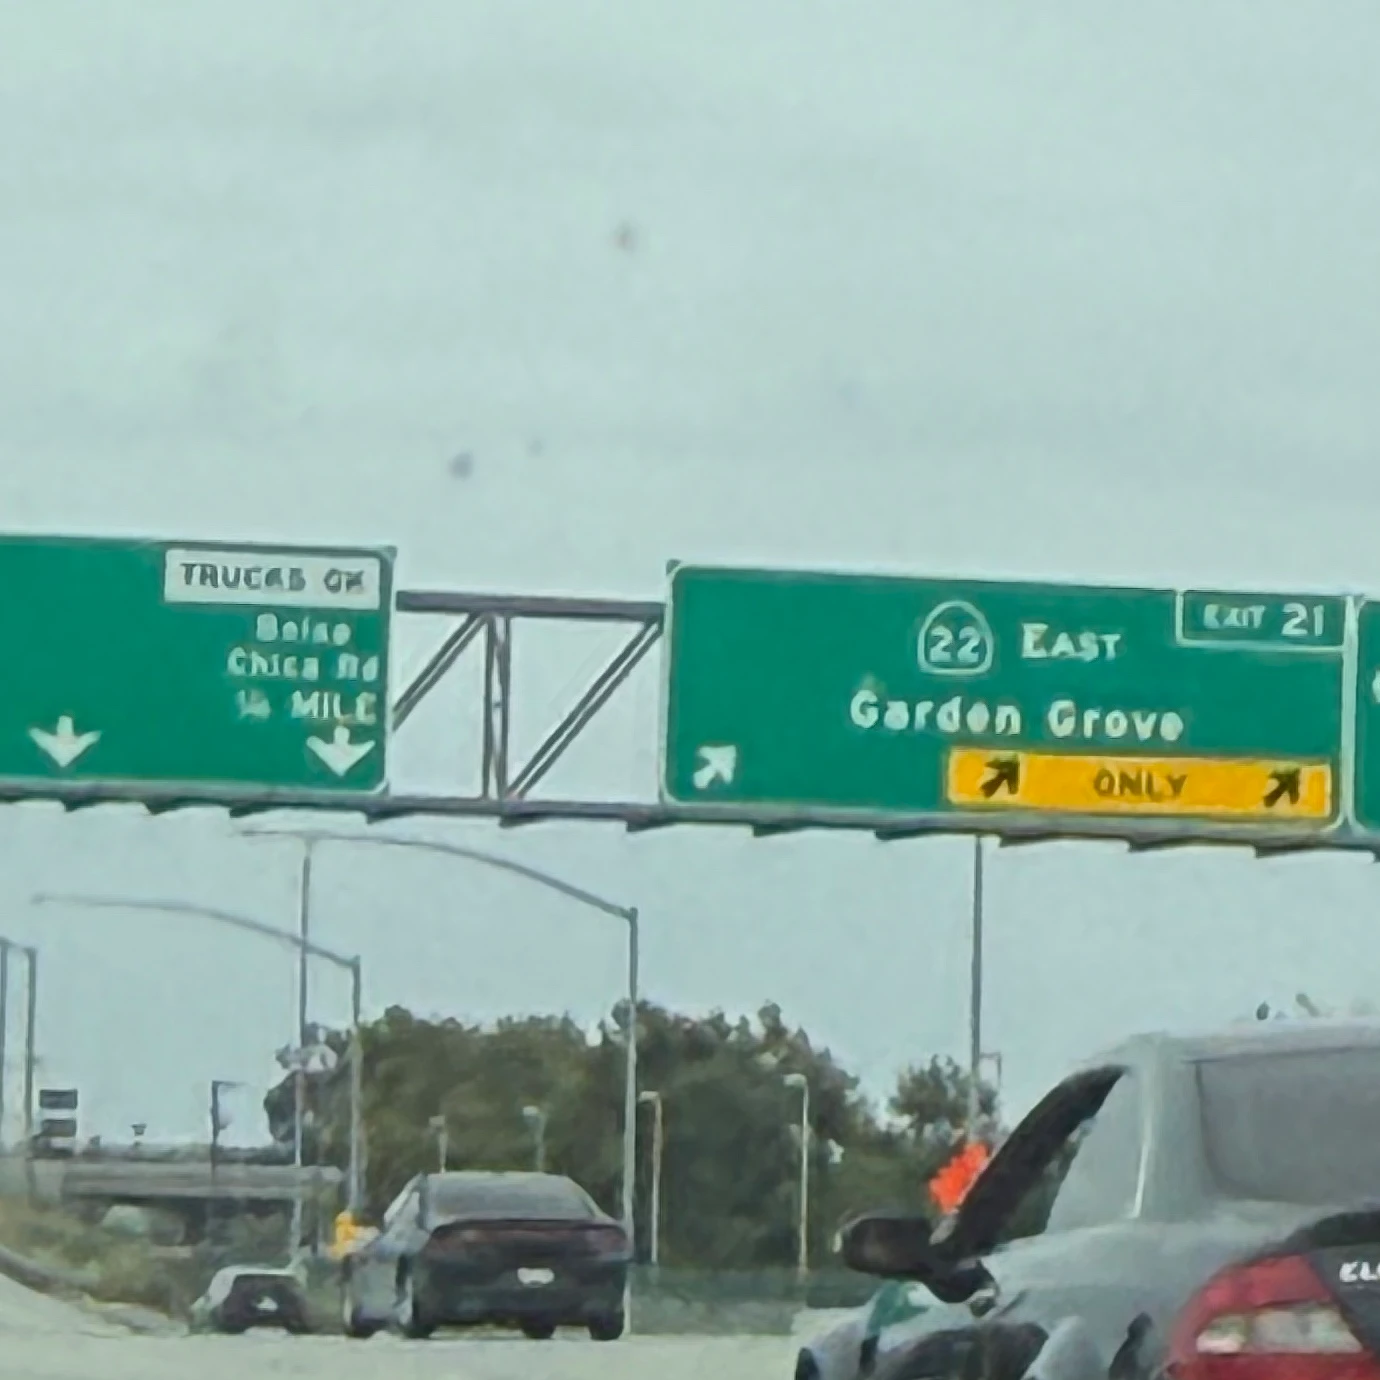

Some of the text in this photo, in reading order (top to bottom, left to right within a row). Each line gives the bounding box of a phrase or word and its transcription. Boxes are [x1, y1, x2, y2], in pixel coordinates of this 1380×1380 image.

[323, 567, 365, 593] OK
[1203, 602, 1325, 637] EXIT 21
[928, 622, 1121, 663] 22 EAST
[290, 690, 378, 725] MILE
[850, 690, 1184, 742] Garden Grove
[1092, 769, 1187, 799] ONLY
